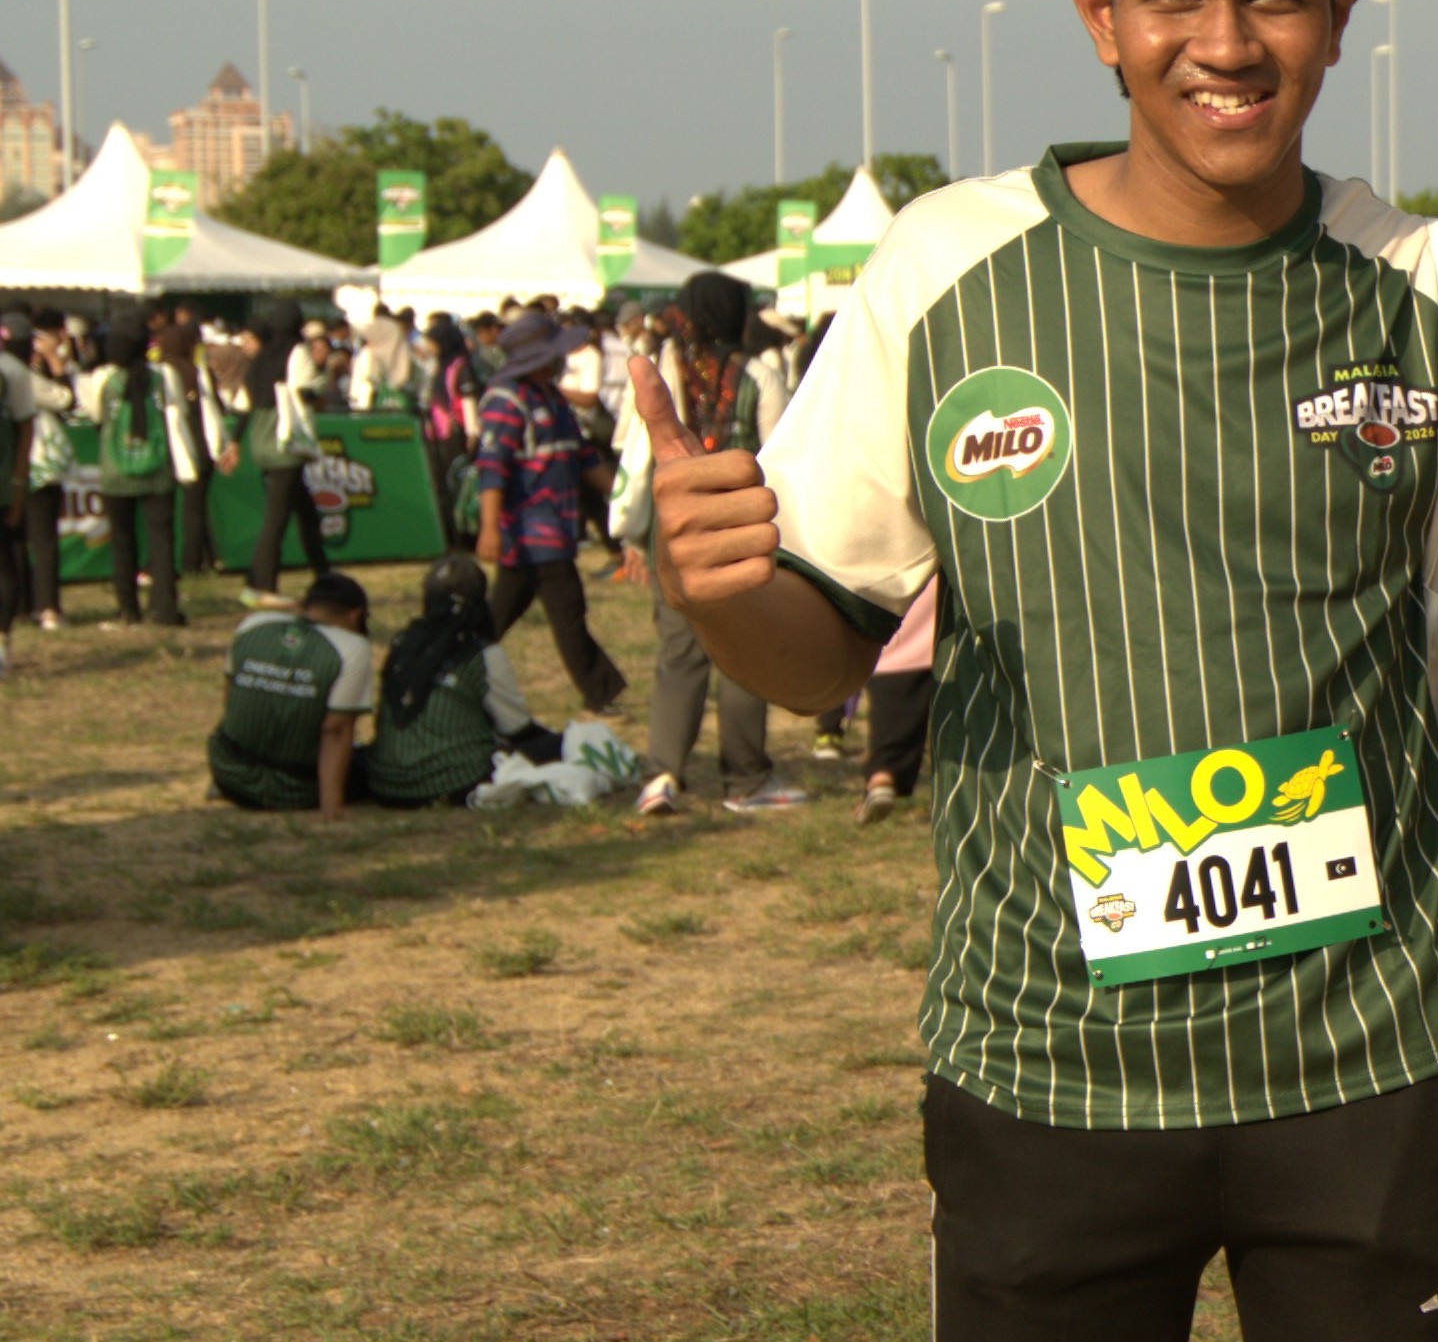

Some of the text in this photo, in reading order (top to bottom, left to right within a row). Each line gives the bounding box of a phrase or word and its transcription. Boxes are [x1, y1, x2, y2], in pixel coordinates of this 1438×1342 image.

[962, 426, 1043, 466] MILO
[1311, 427, 1435, 443] DAY 2026
[1062, 749, 1265, 885] MILO
[1163, 841, 1300, 934] 4041
